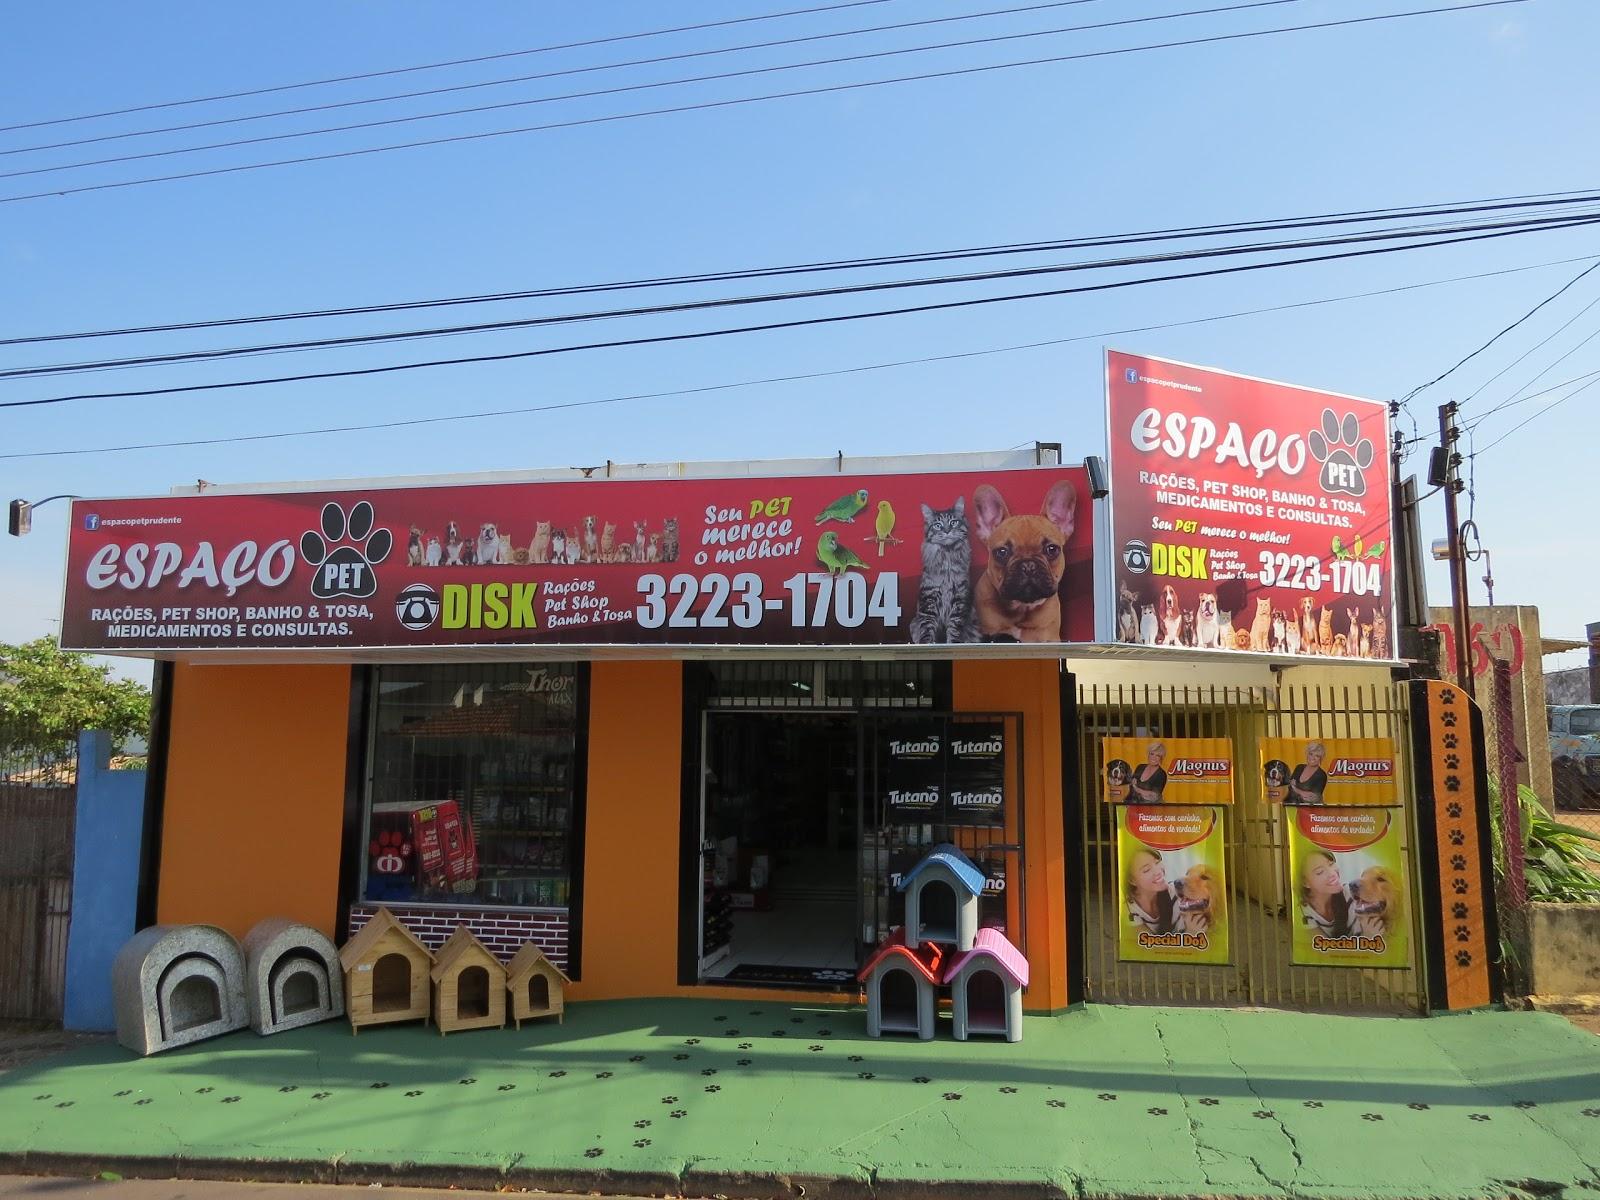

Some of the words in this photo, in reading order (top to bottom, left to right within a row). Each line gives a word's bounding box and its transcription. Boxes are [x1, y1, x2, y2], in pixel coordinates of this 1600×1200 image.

[1139, 375, 1202, 393] espacopetprudente
[1130, 407, 1306, 479] ESPAÇO
[1328, 462, 1357, 488] PET
[1139, 471, 1200, 491] RAÇÕES,
[1203, 480, 1229, 496] PET
[1231, 484, 1269, 503] SHOP,
[1272, 489, 1315, 508] BANHO
[1318, 498, 1328, 509] &
[1331, 499, 1366, 516] TOSA,
[704, 505, 742, 525] Seu
[749, 496, 792, 520] PET
[1156, 490, 1263, 517] MEDICAMENTOS
[1266, 506, 1275, 518] E
[1278, 507, 1353, 529] CONSULTAS.
[101, 514, 182, 528] espacopetprudente
[1152, 516, 1172, 531] Seu
[1174, 519, 1198, 533] PET
[1200, 525, 1237, 540] merece
[1239, 531, 1247, 540] o
[1249, 530, 1291, 545] melhor!
[701, 518, 792, 547] merece
[694, 551, 708, 566] o
[715, 536, 802, 564] melhor!
[1151, 542, 1208, 580] DISK
[1210, 549, 1238, 560] Rações
[86, 539, 295, 597] ESPAÇO
[1211, 560, 1224, 571] Pet
[1226, 561, 1246, 571] Shop
[1259, 551, 1381, 597] 3223-1704
[324, 562, 365, 591] PET
[1213, 571, 1235, 582] Banho
[1243, 571, 1258, 581] Tosa
[543, 579, 595, 597] Rações
[442, 583, 537, 630] DISK
[544, 598, 567, 613] Pet
[572, 596, 608, 612] Shop
[637, 572, 901, 629] 3223-1704
[91, 604, 157, 622] RAÇÕES,
[162, 607, 191, 621] PET
[196, 605, 240, 624] SHOP,
[246, 605, 303, 620] BANHO
[309, 605, 319, 619] &
[326, 604, 374, 620] TOSA,
[547, 614, 588, 629] Banho
[593, 613, 601, 624] &
[603, 609, 632, 622] Tosa
[108, 623, 232, 637] MEDICAMENTOS
[237, 625, 246, 637] E
[252, 623, 353, 637] CONSULTAS.
[525, 668, 576, 693] Thor
[889, 740, 940, 756] Tutano
[951, 740, 1003, 756] Tutano
[1168, 759, 1228, 776] Magnus
[1328, 759, 1390, 777] Magnus
[888, 790, 939, 805] Tutano
[950, 791, 1002, 806] Tutano
[1139, 933, 1181, 948] Special
[1183, 933, 1208, 949] Dog
[1313, 936, 1357, 951] Special
[1359, 936, 1385, 952] Dog
